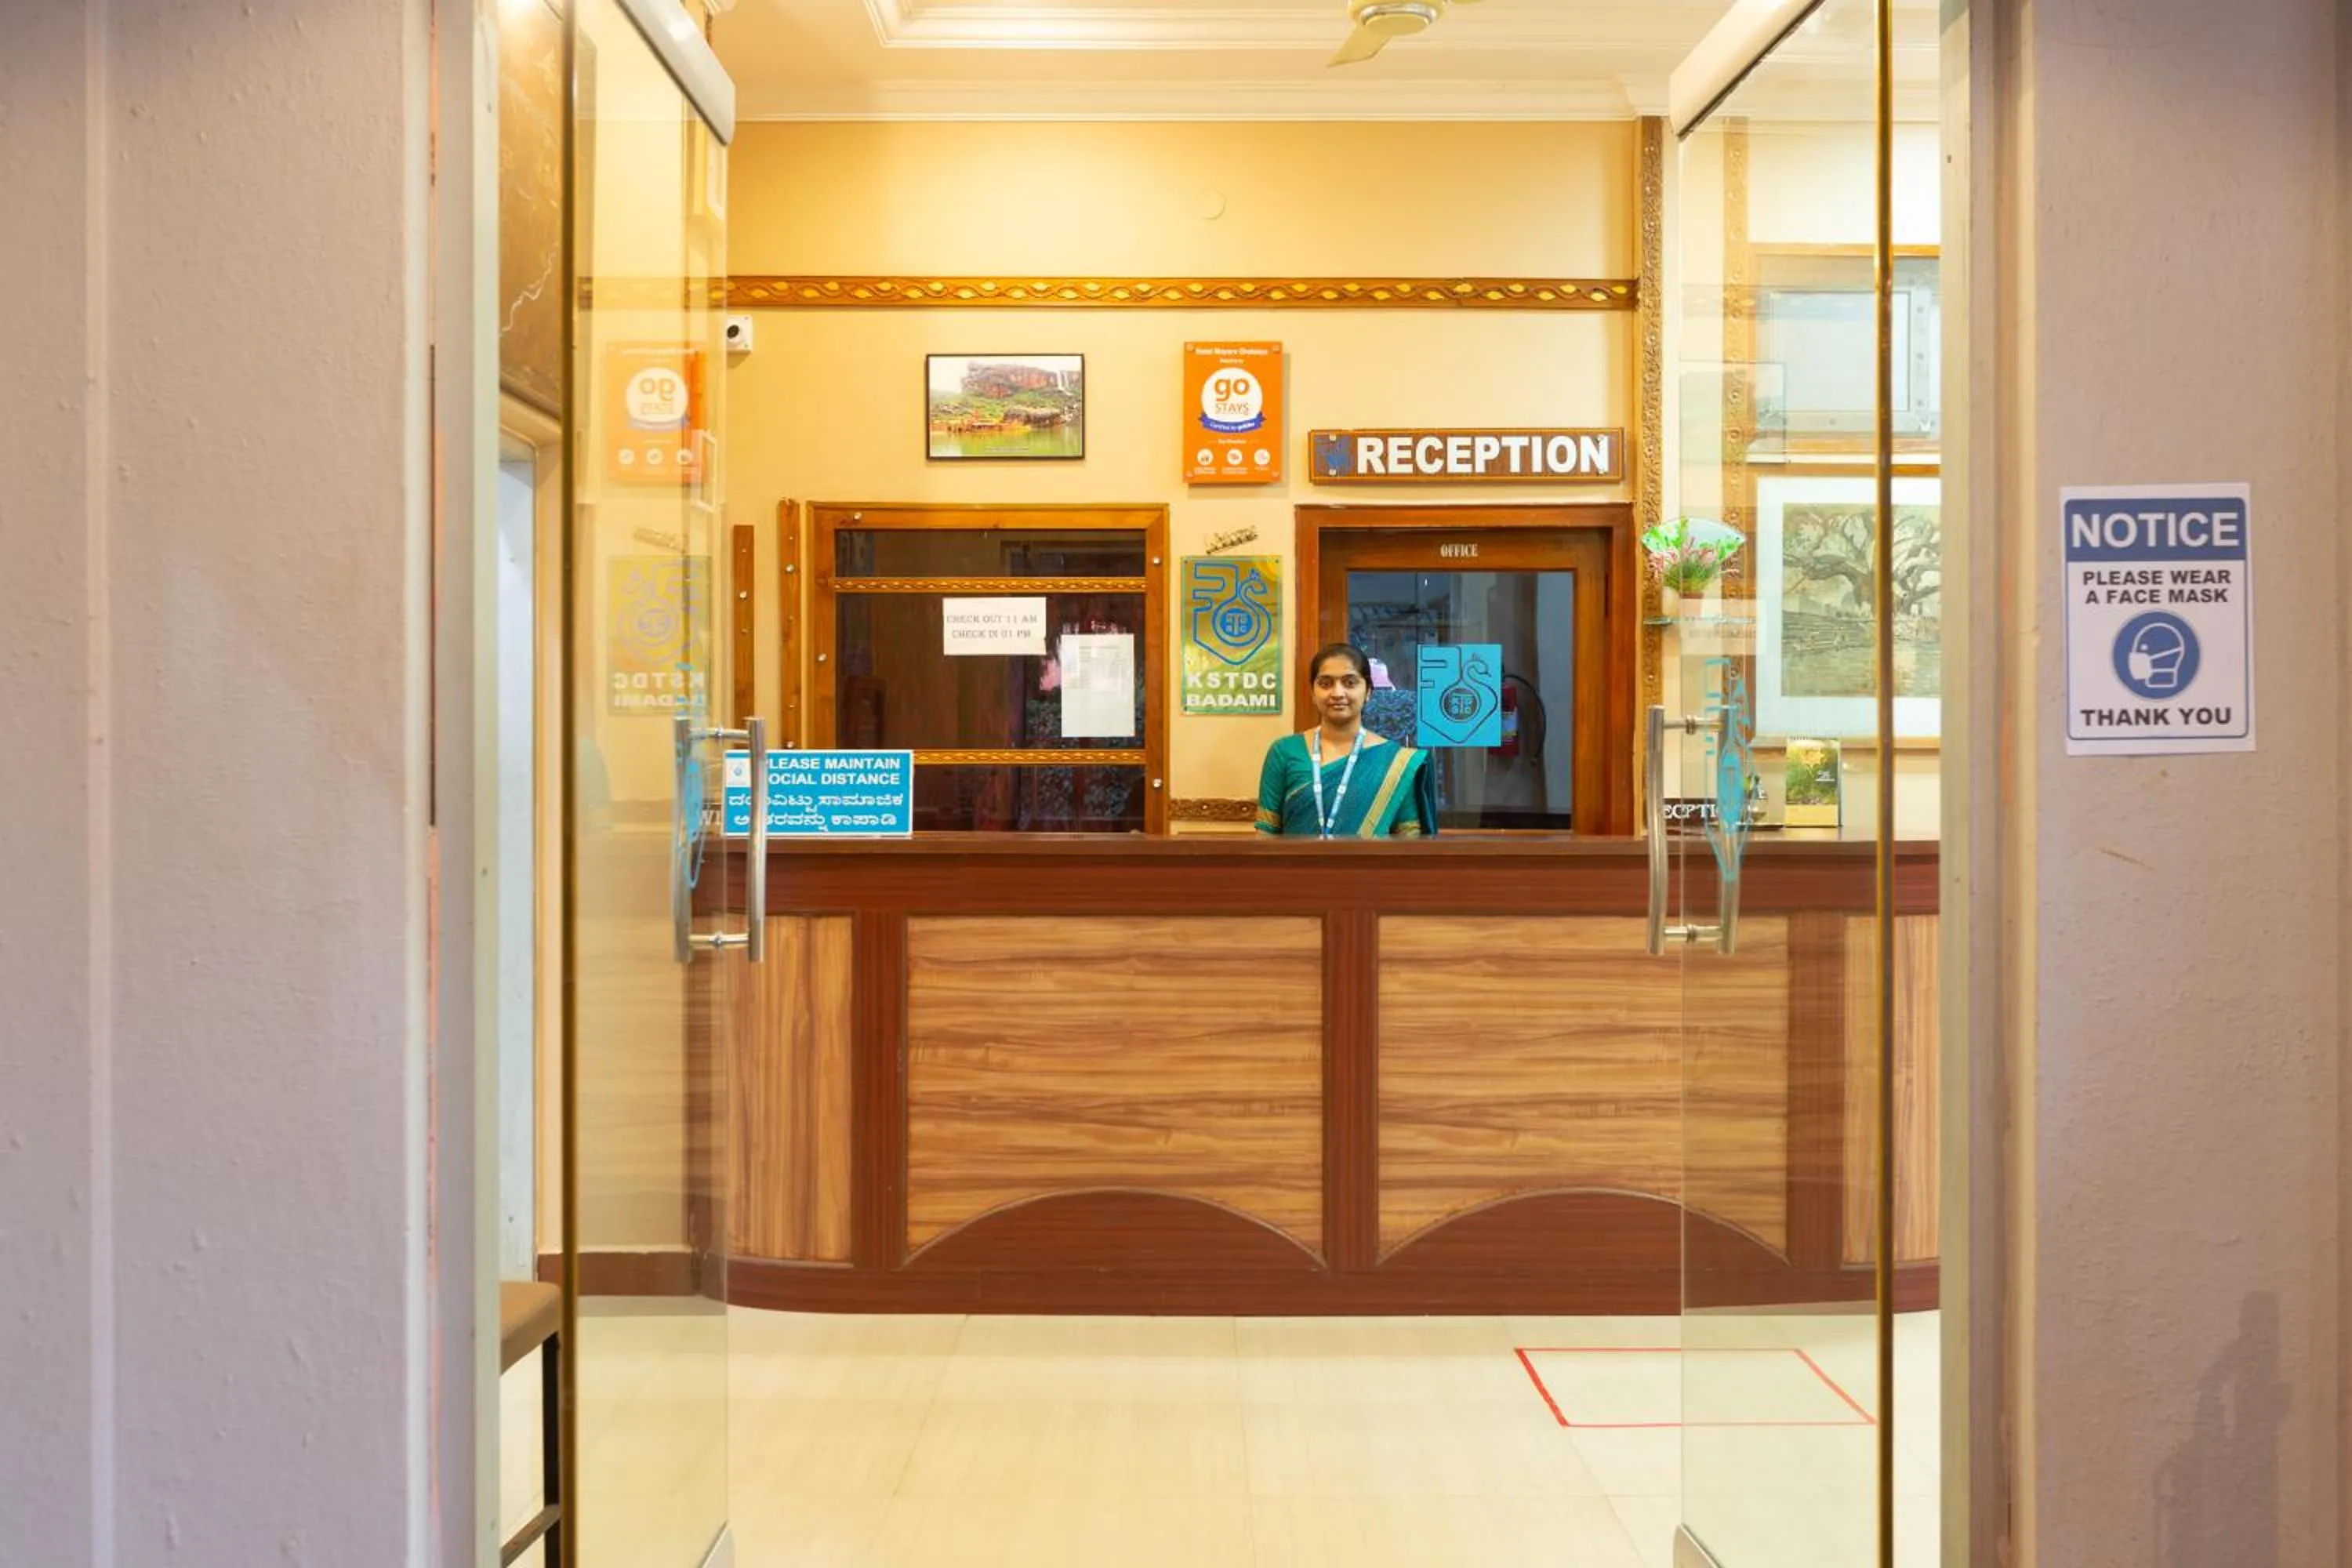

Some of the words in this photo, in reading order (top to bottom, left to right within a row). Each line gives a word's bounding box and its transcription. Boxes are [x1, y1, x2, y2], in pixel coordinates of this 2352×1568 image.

[1214, 378, 1250, 401] go
[1214, 403, 1250, 415] STAYS
[1357, 436, 1610, 474] RECEPTION
[2072, 512, 2240, 548] NOTICE
[1440, 544, 1478, 557] OFFICE
[2083, 571, 2163, 586] PLEASE
[2170, 570, 2232, 585] WEAR
[2085, 590, 2100, 604] A
[2107, 590, 2160, 604] FACE
[2168, 589, 2228, 604] MASK
[946, 614, 980, 624] CHECK
[982, 614, 1003, 624] OUT
[1021, 615, 1037, 624] AM
[952, 629, 985, 639] CHECK
[989, 629, 999, 638] IN
[1017, 629, 1032, 638] PM
[1187, 672, 1277, 689] KSTDC
[1185, 694, 1276, 707] BADAMI
[2081, 709, 2170, 726] THANK
[2179, 707, 2232, 725] YOU
[768, 757, 821, 769] LEASE
[825, 758, 900, 769] MAINTAIN
[768, 772, 818, 785] OCIAL
[821, 773, 901, 785] DISTANCE
